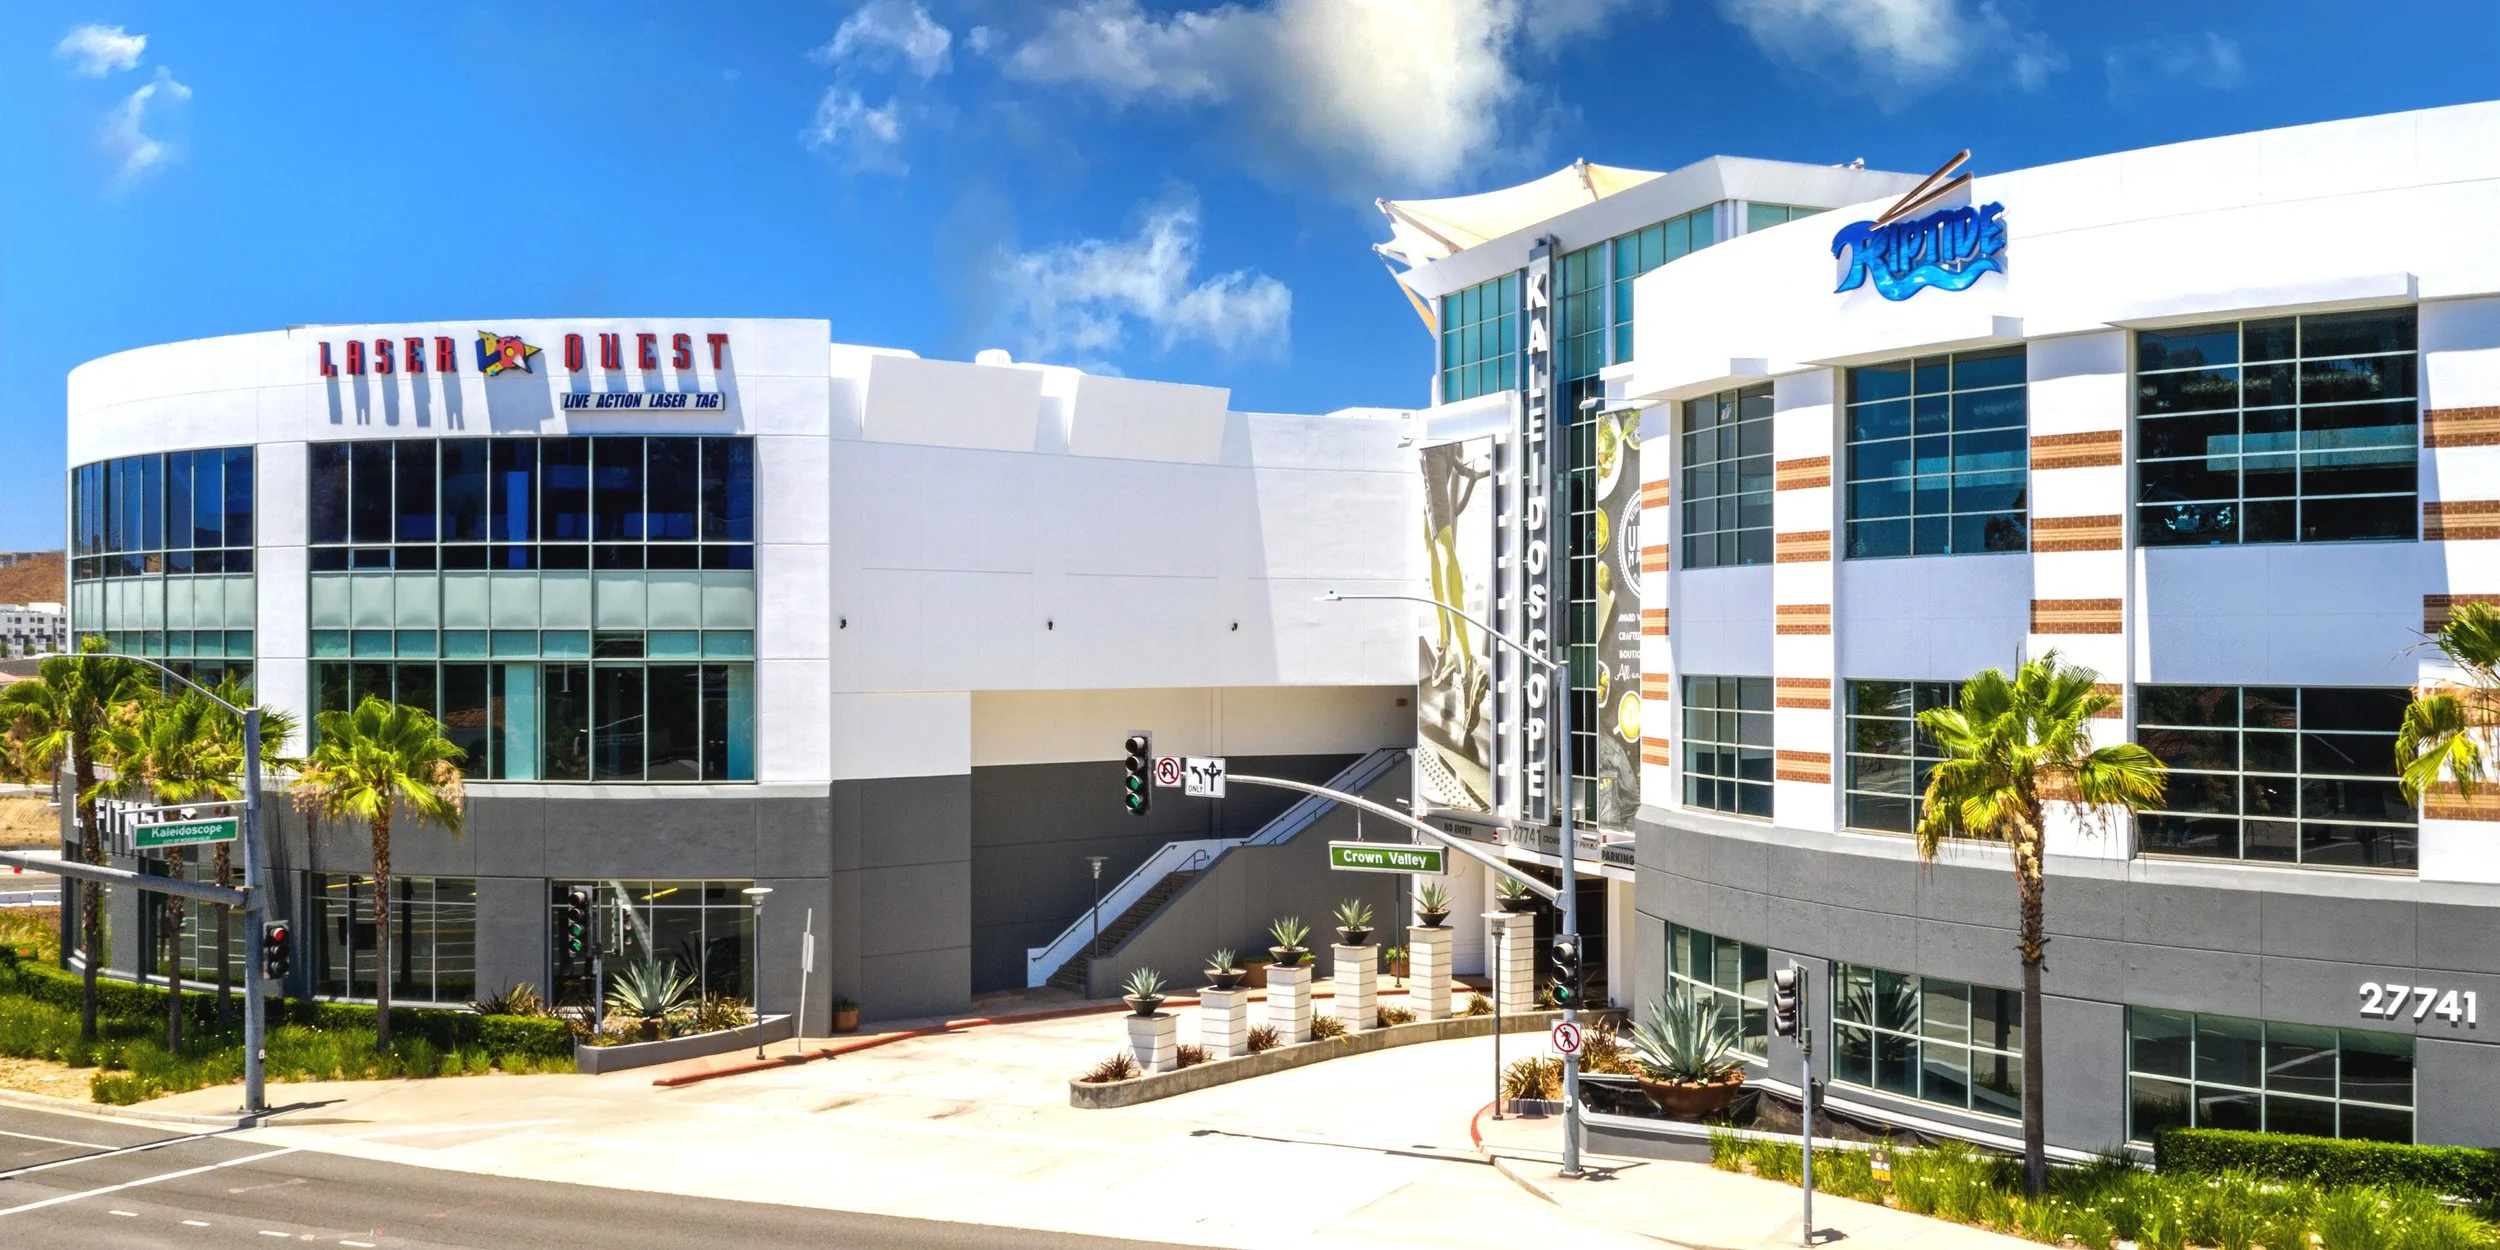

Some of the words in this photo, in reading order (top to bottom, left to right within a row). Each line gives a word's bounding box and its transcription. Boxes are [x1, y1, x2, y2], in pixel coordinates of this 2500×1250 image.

[1831, 201, 2005, 293] RIPTIDE
[318, 336, 456, 376] LASER
[564, 333, 728, 373] QUEST
[564, 393, 590, 408] LIVE
[596, 393, 642, 408] ACTION
[649, 393, 687, 408] LASER
[695, 393, 719, 408] TAG
[1527, 273, 1549, 798] KALEIDOSCOPE
[1188, 785, 1203, 793] ONLY
[152, 825, 223, 838] Kaleidoscope
[1444, 823, 1453, 832] NO
[1455, 825, 1472, 836] ENTRY
[1513, 825, 1540, 847] 27741
[1343, 850, 1383, 864] Crown
[1389, 852, 1427, 869] Valley
[1602, 850, 1635, 866] PARKING
[2359, 982, 2476, 1023] 27741
